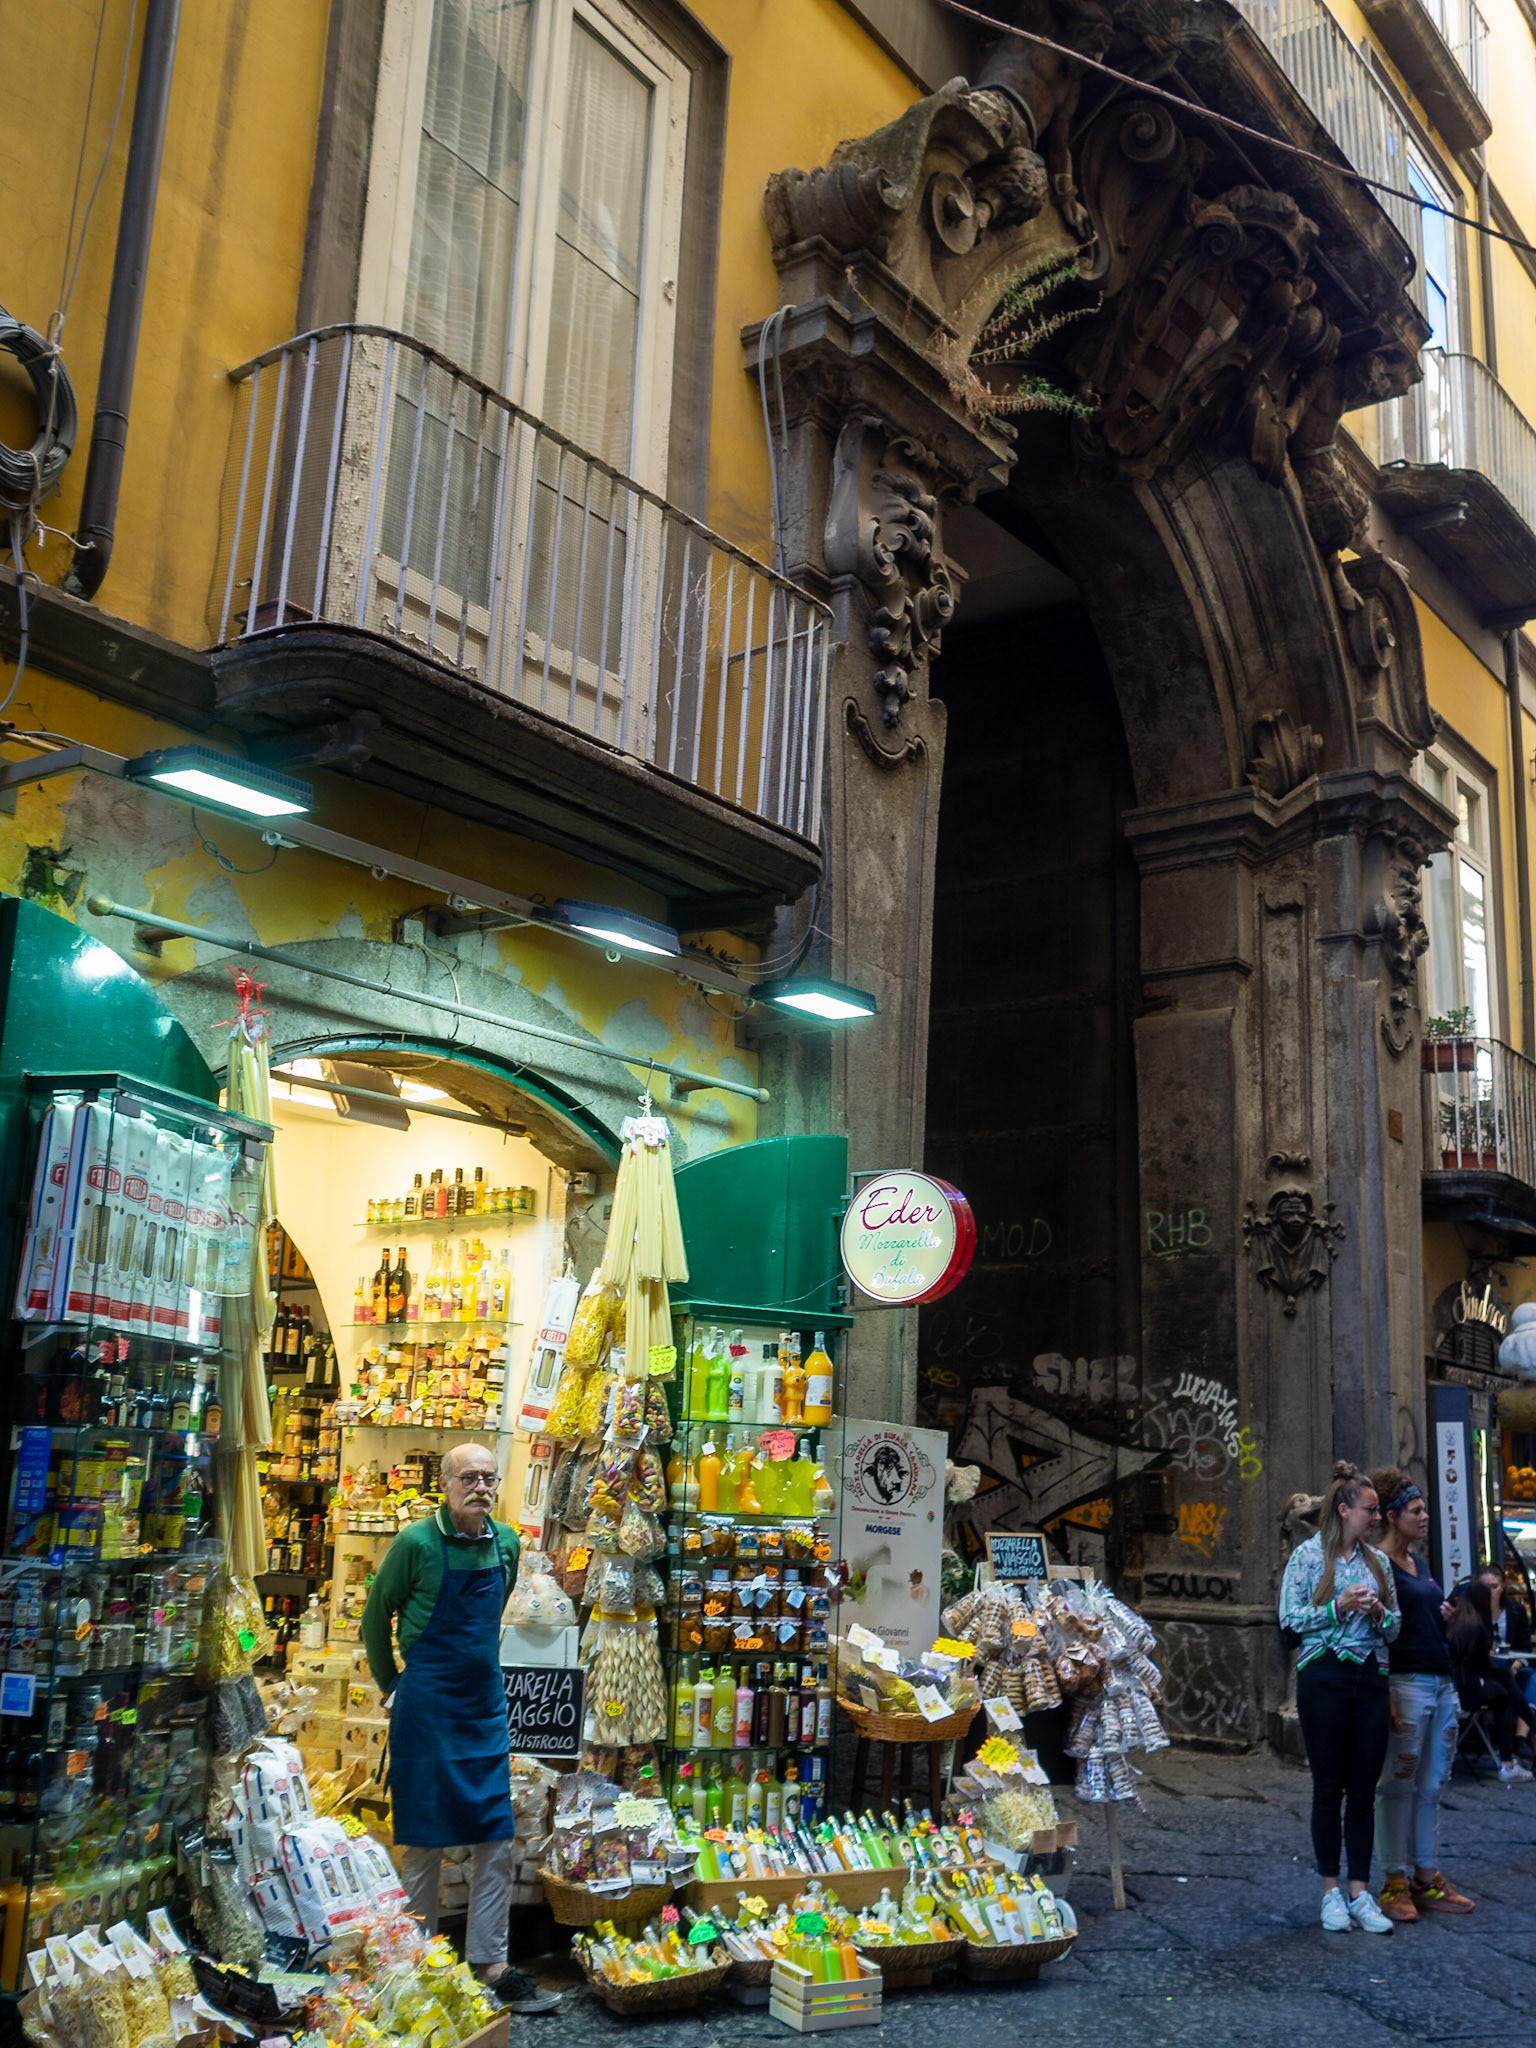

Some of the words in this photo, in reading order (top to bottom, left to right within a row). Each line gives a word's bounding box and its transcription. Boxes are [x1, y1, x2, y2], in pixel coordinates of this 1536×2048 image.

[91, 1169, 120, 1190] FALLA
[860, 1186, 943, 1231] Eder
[859, 1231, 940, 1251] Mozzarella
[1146, 1208, 1213, 1255] RHB
[890, 1250, 906, 1267] di
[873, 1266, 922, 1290] Bufala
[542, 1330, 566, 1343] FAELLA
[883, 1432, 909, 1450] BUFALA
[908, 1451, 920, 1497] CAMPANA
[865, 1524, 901, 1535] MORGESE
[1000, 1551, 1042, 1567] VIAGGIO
[878, 1626, 909, 1637] Giovanni
